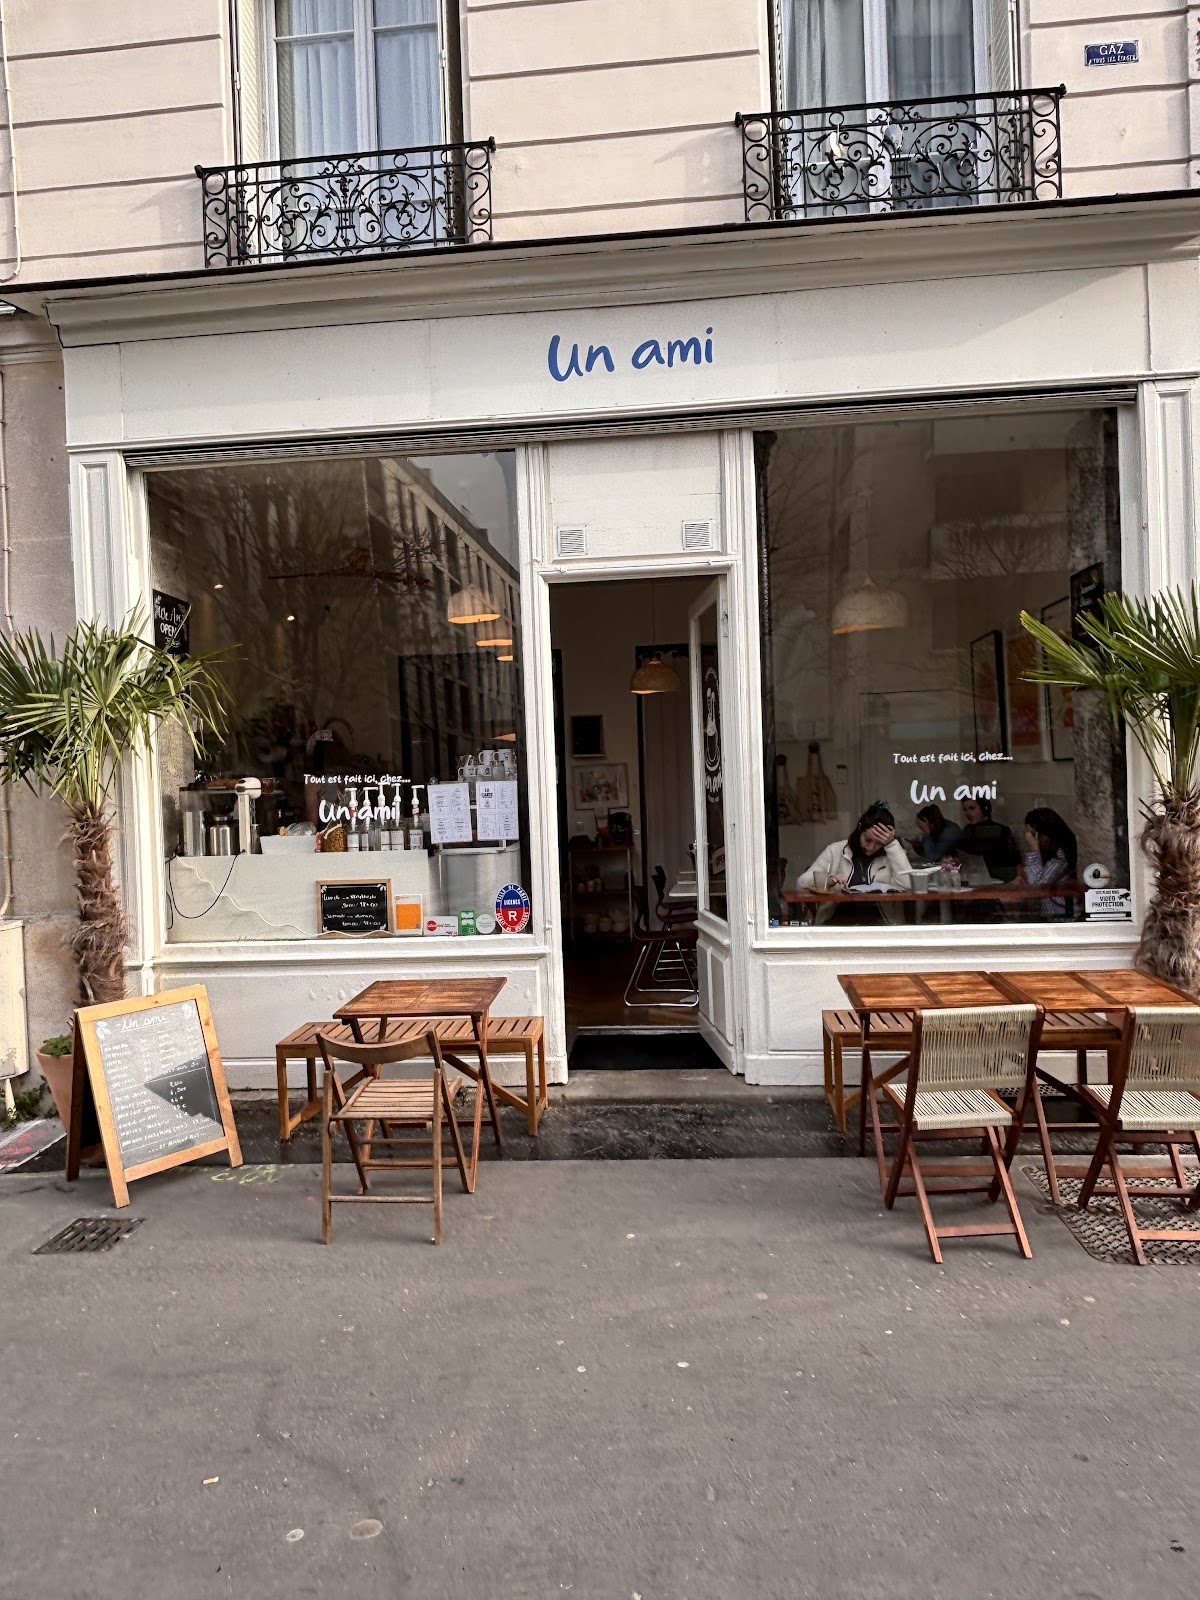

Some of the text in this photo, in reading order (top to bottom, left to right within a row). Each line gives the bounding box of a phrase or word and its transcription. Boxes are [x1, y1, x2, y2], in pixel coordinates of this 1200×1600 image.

[1099, 43, 1125, 56] GAZ
[548, 326, 714, 382] Un ami
[893, 751, 1014, 764] Tout est fait ici, chez...
[303, 773, 326, 784] Tout
[327, 774, 342, 784] est
[344, 774, 362, 785] fait
[364, 774, 378, 784] ici,
[910, 779, 998, 805] Un ami
[318, 799, 396, 823] Un ami
[508, 910, 518, 922] R
